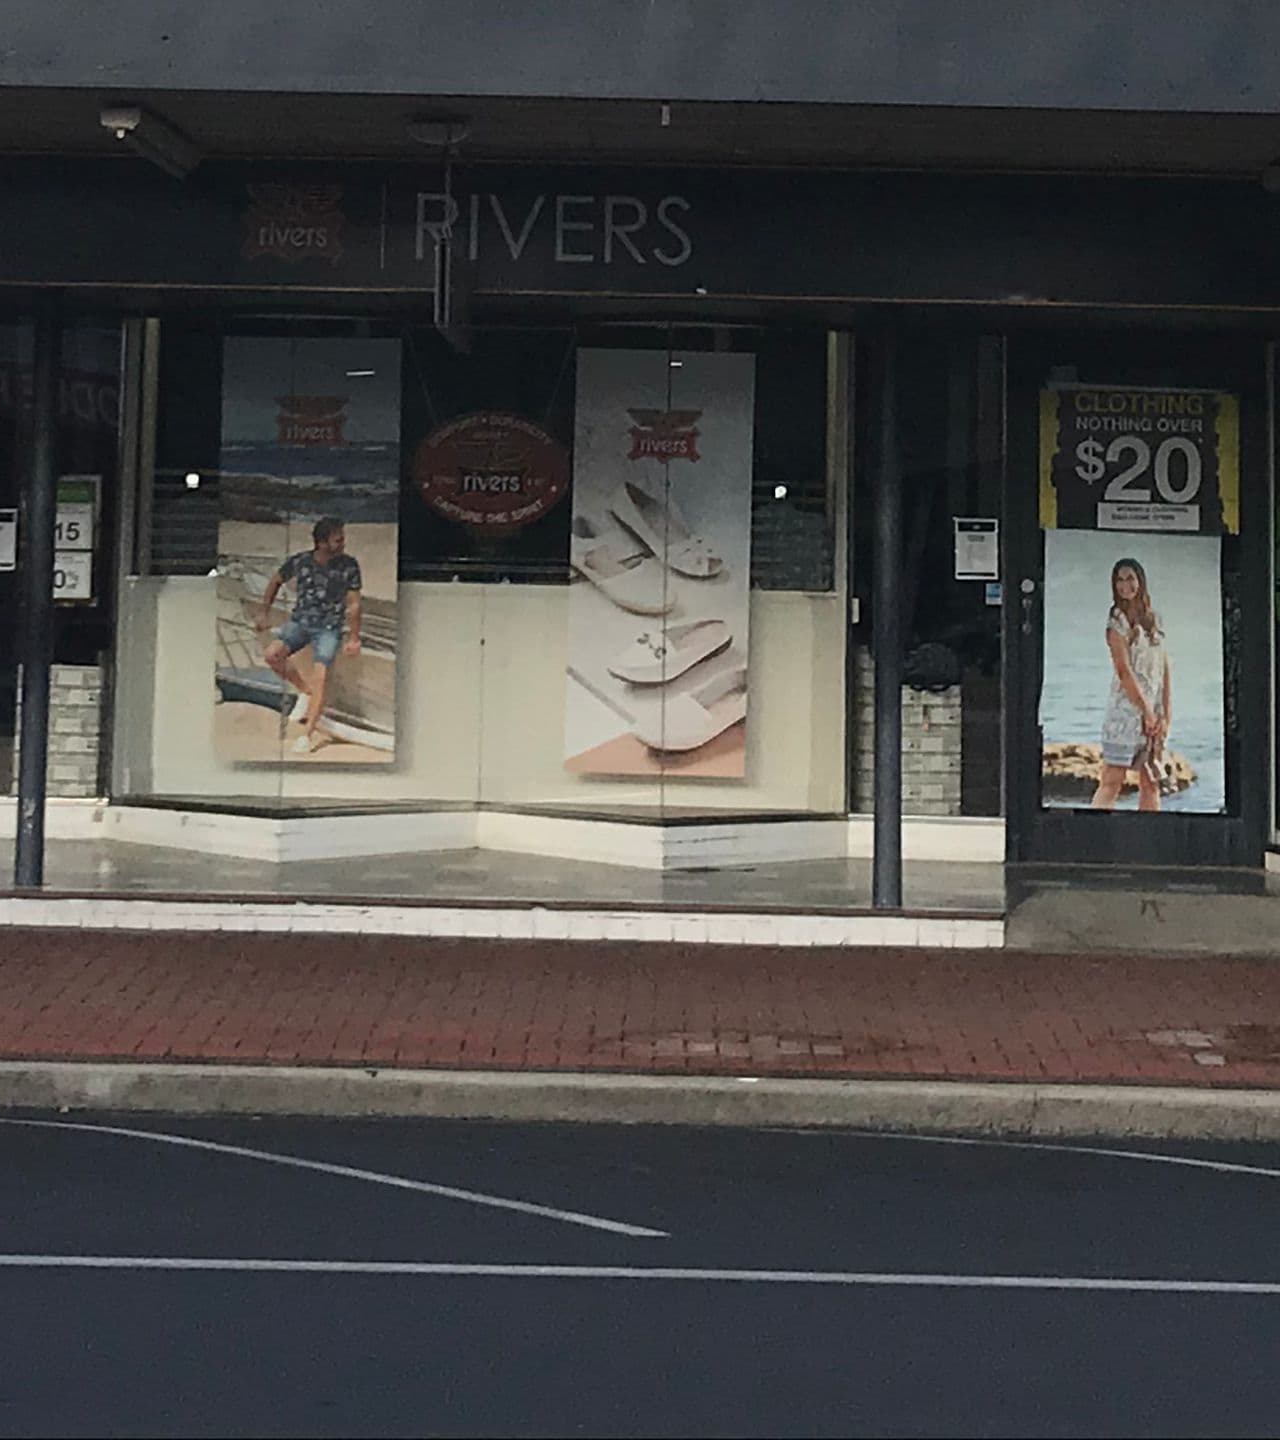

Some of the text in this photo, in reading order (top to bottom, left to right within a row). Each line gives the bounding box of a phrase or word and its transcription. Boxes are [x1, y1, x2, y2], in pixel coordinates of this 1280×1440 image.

[259, 222, 328, 248] rivers
[415, 191, 694, 267] RIVERS
[1075, 393, 1203, 414] CLOTHING
[1075, 416, 1203, 433] NOTHING OVER
[640, 440, 688, 453] rivers
[1075, 435, 1202, 503] $20
[463, 472, 521, 492] rivers
